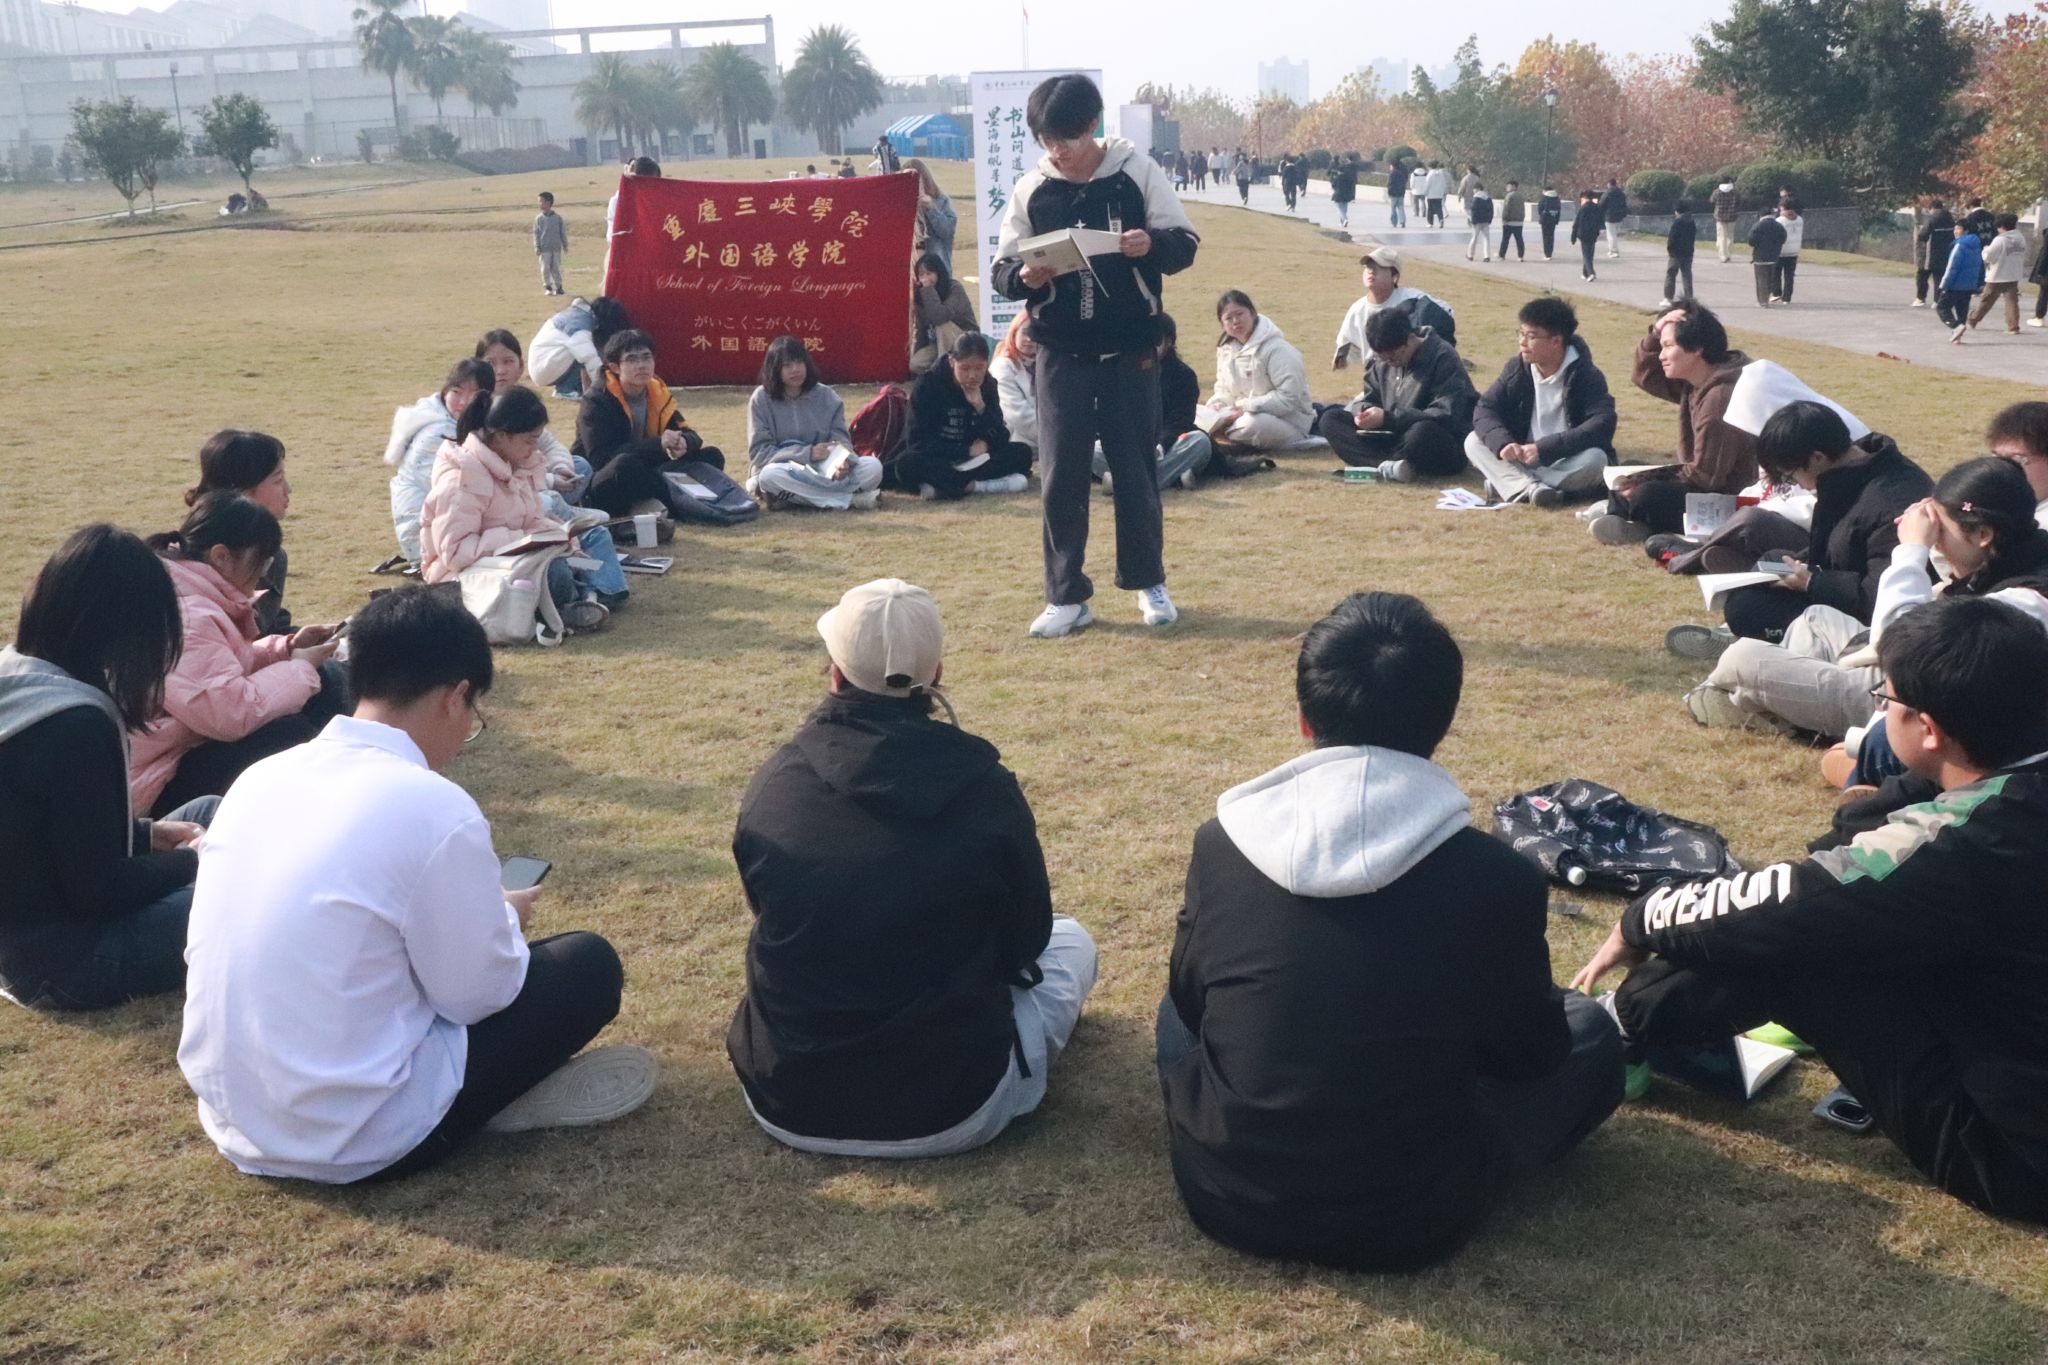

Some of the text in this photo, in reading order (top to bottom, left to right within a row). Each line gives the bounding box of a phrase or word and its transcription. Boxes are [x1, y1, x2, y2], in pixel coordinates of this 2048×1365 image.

[656, 273, 866, 300] School of Foreign Languages
[694, 315, 822, 331] がいこくごがくいん
[690, 335, 825, 352] 外国語院
